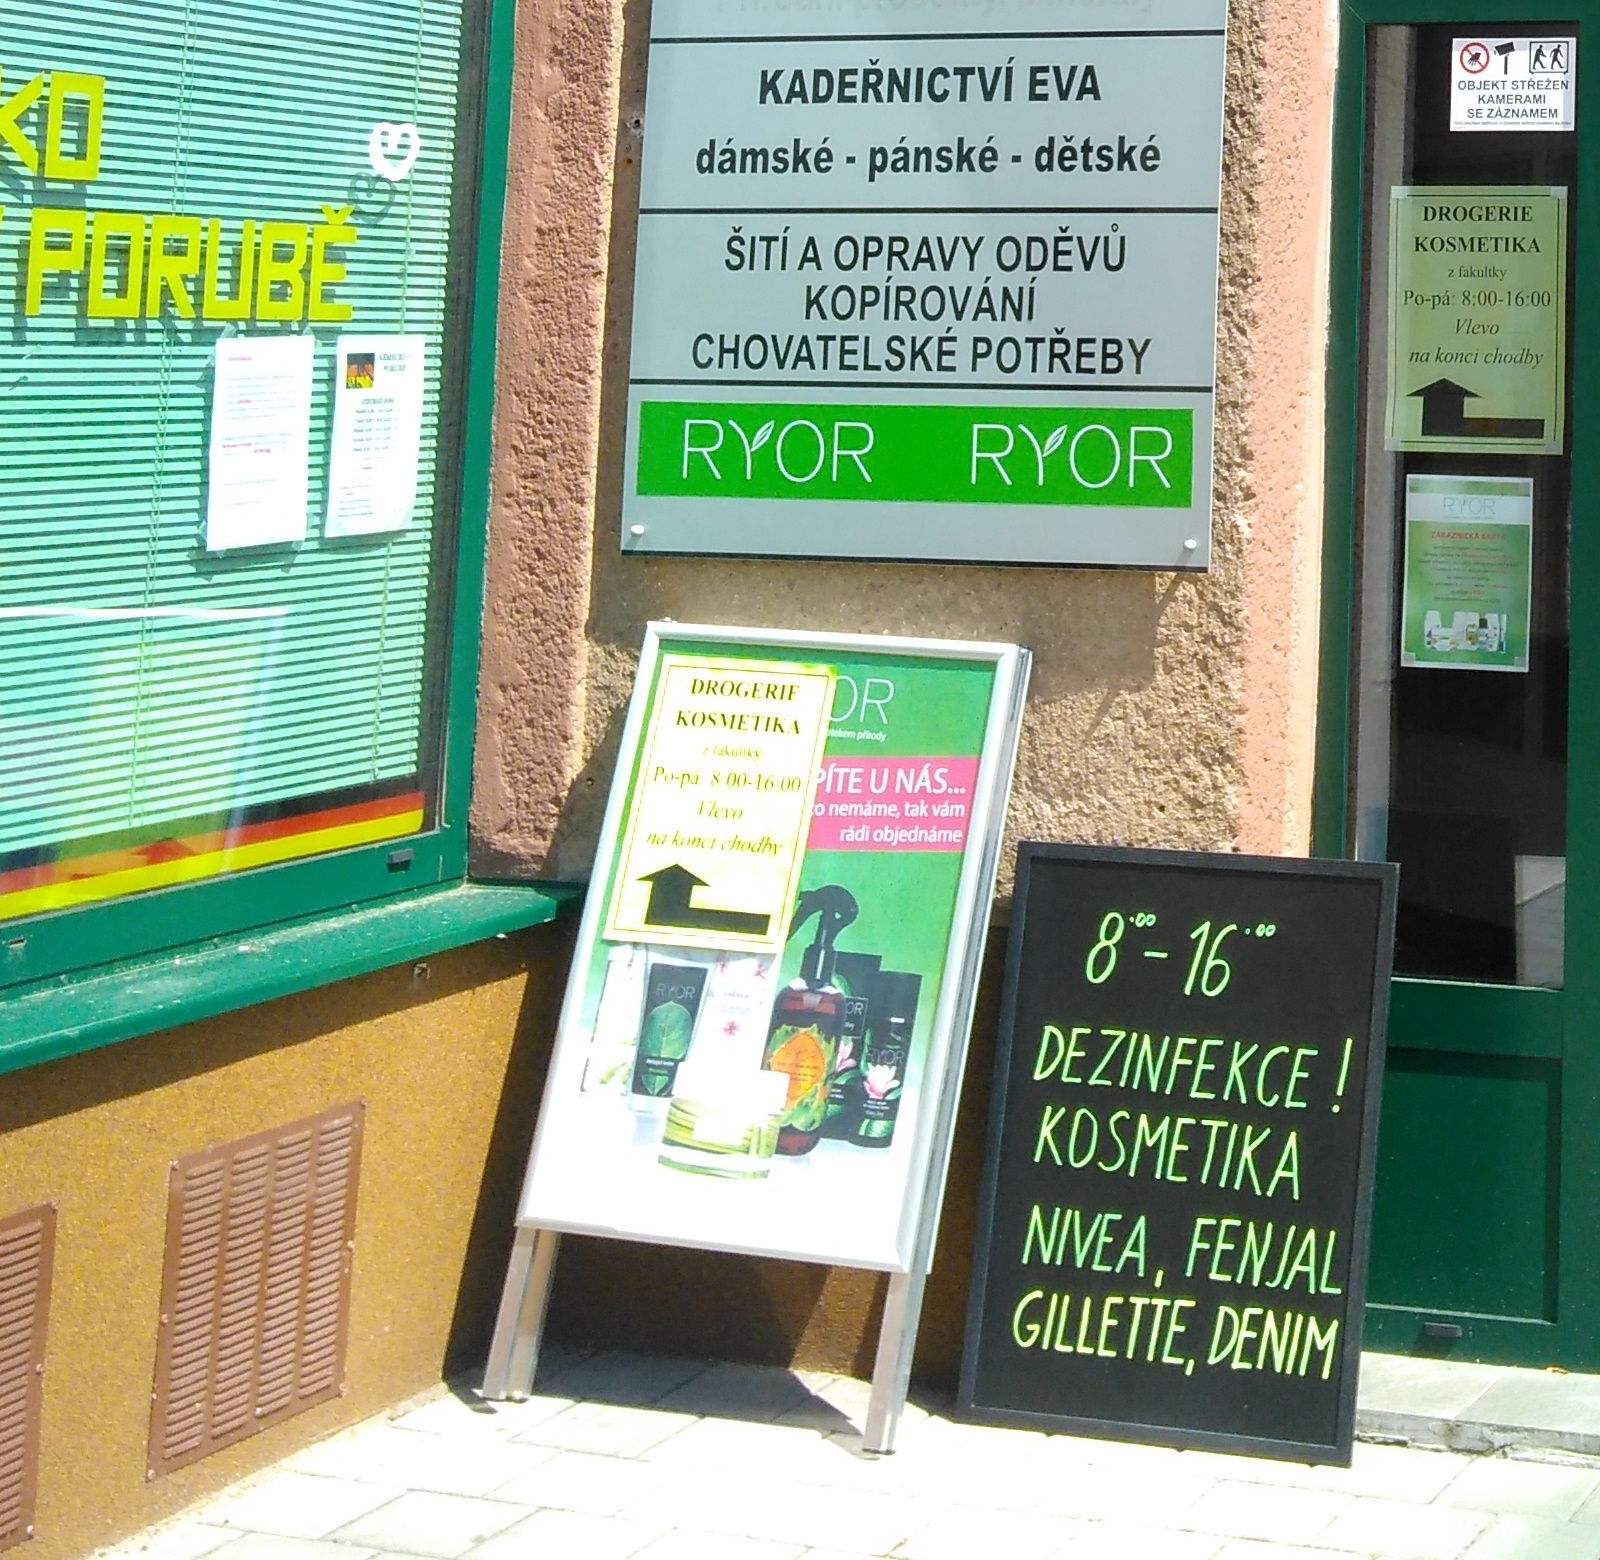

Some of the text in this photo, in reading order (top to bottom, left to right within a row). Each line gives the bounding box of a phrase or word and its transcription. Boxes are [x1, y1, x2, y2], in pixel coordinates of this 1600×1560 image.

[758, 57, 1102, 105] KADEŘNICTVÍ EVA
[1457, 78, 1569, 91] OBJEKT STŘEŽEN
[1467, 106, 1558, 119] SE ZÁZNAMEM
[1477, 94, 1546, 105] KAMERAMI
[696, 137, 834, 175] dámské
[868, 136, 999, 182] pánské
[1034, 134, 1161, 173] dětské
[1423, 205, 1533, 222] DROGERIE
[724, 222, 1127, 272] ŠITÍ A OPRAVY ODĚVŮ
[1414, 236, 1542, 253] KOSMETIKA
[25, 203, 358, 321] PORUBĚ
[1448, 265, 1507, 281] z fakultky
[804, 276, 1038, 322] KOPÍROVÁNÍ
[1462, 290, 1551, 307] 8:00-16:00
[1456, 318, 1500, 335] Vlevo
[692, 326, 1152, 375] CHOVATELSKÉ POTŘEBY
[1410, 347, 1544, 369] na konci chodby
[682, 418, 874, 483] RYOR
[970, 422, 1173, 489] RYOR
[676, 710, 801, 735] KOSMETIKA
[870, 767, 889, 794] U
[895, 762, 967, 794] NÁS...
[829, 800, 901, 818] nemáme,
[904, 799, 929, 817] tak
[929, 800, 965, 817] vám
[646, 832, 668, 846] na
[720, 834, 782, 856] chodby
[839, 824, 963, 846] rádi objednáme
[1033, 1024, 1319, 1110] DEZINFEKCE
[1033, 1104, 1301, 1200] KOSMETIKA
[1185, 1217, 1341, 1295] FENJAL
[1012, 1290, 1340, 1381] GILLETTE, DENIM
